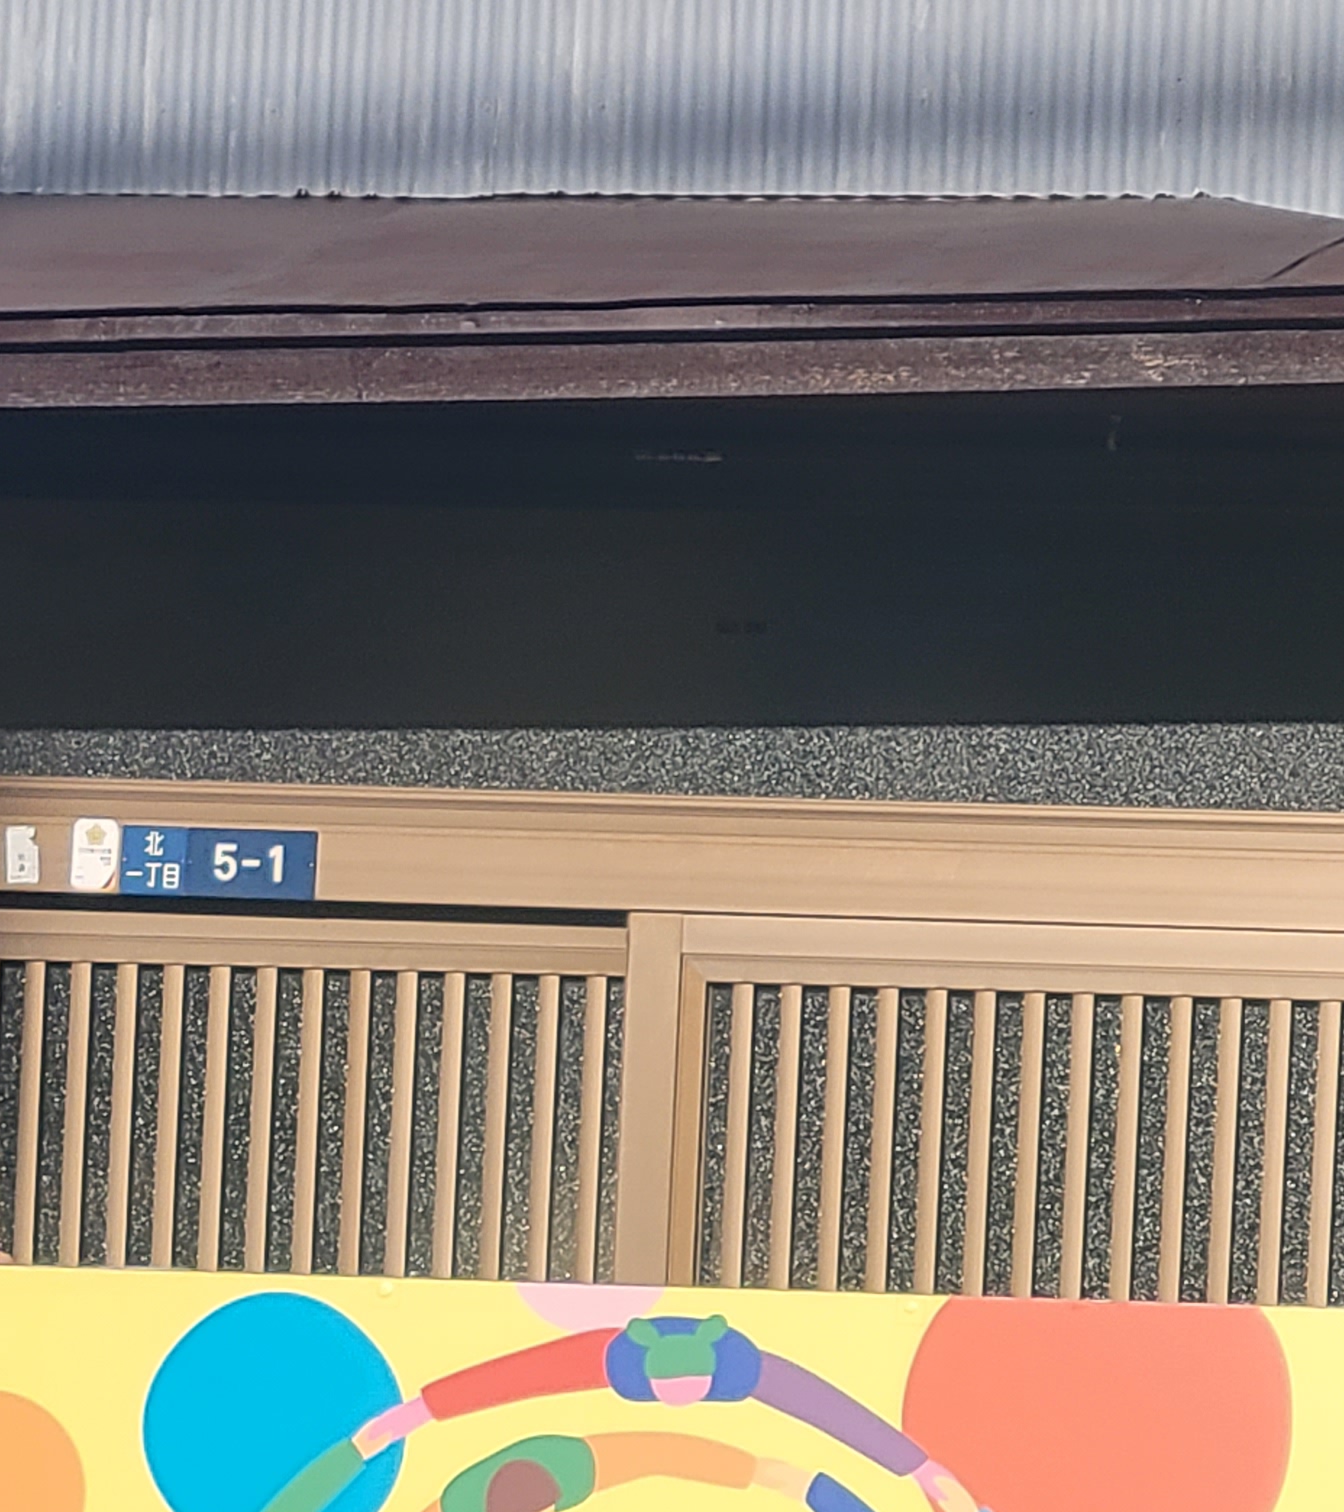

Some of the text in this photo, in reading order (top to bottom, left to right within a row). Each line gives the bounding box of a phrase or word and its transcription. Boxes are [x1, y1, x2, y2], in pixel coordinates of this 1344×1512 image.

[143, 830, 165, 856] 北
[124, 862, 181, 890] 一丁目
[212, 841, 285, 884] 5-1
